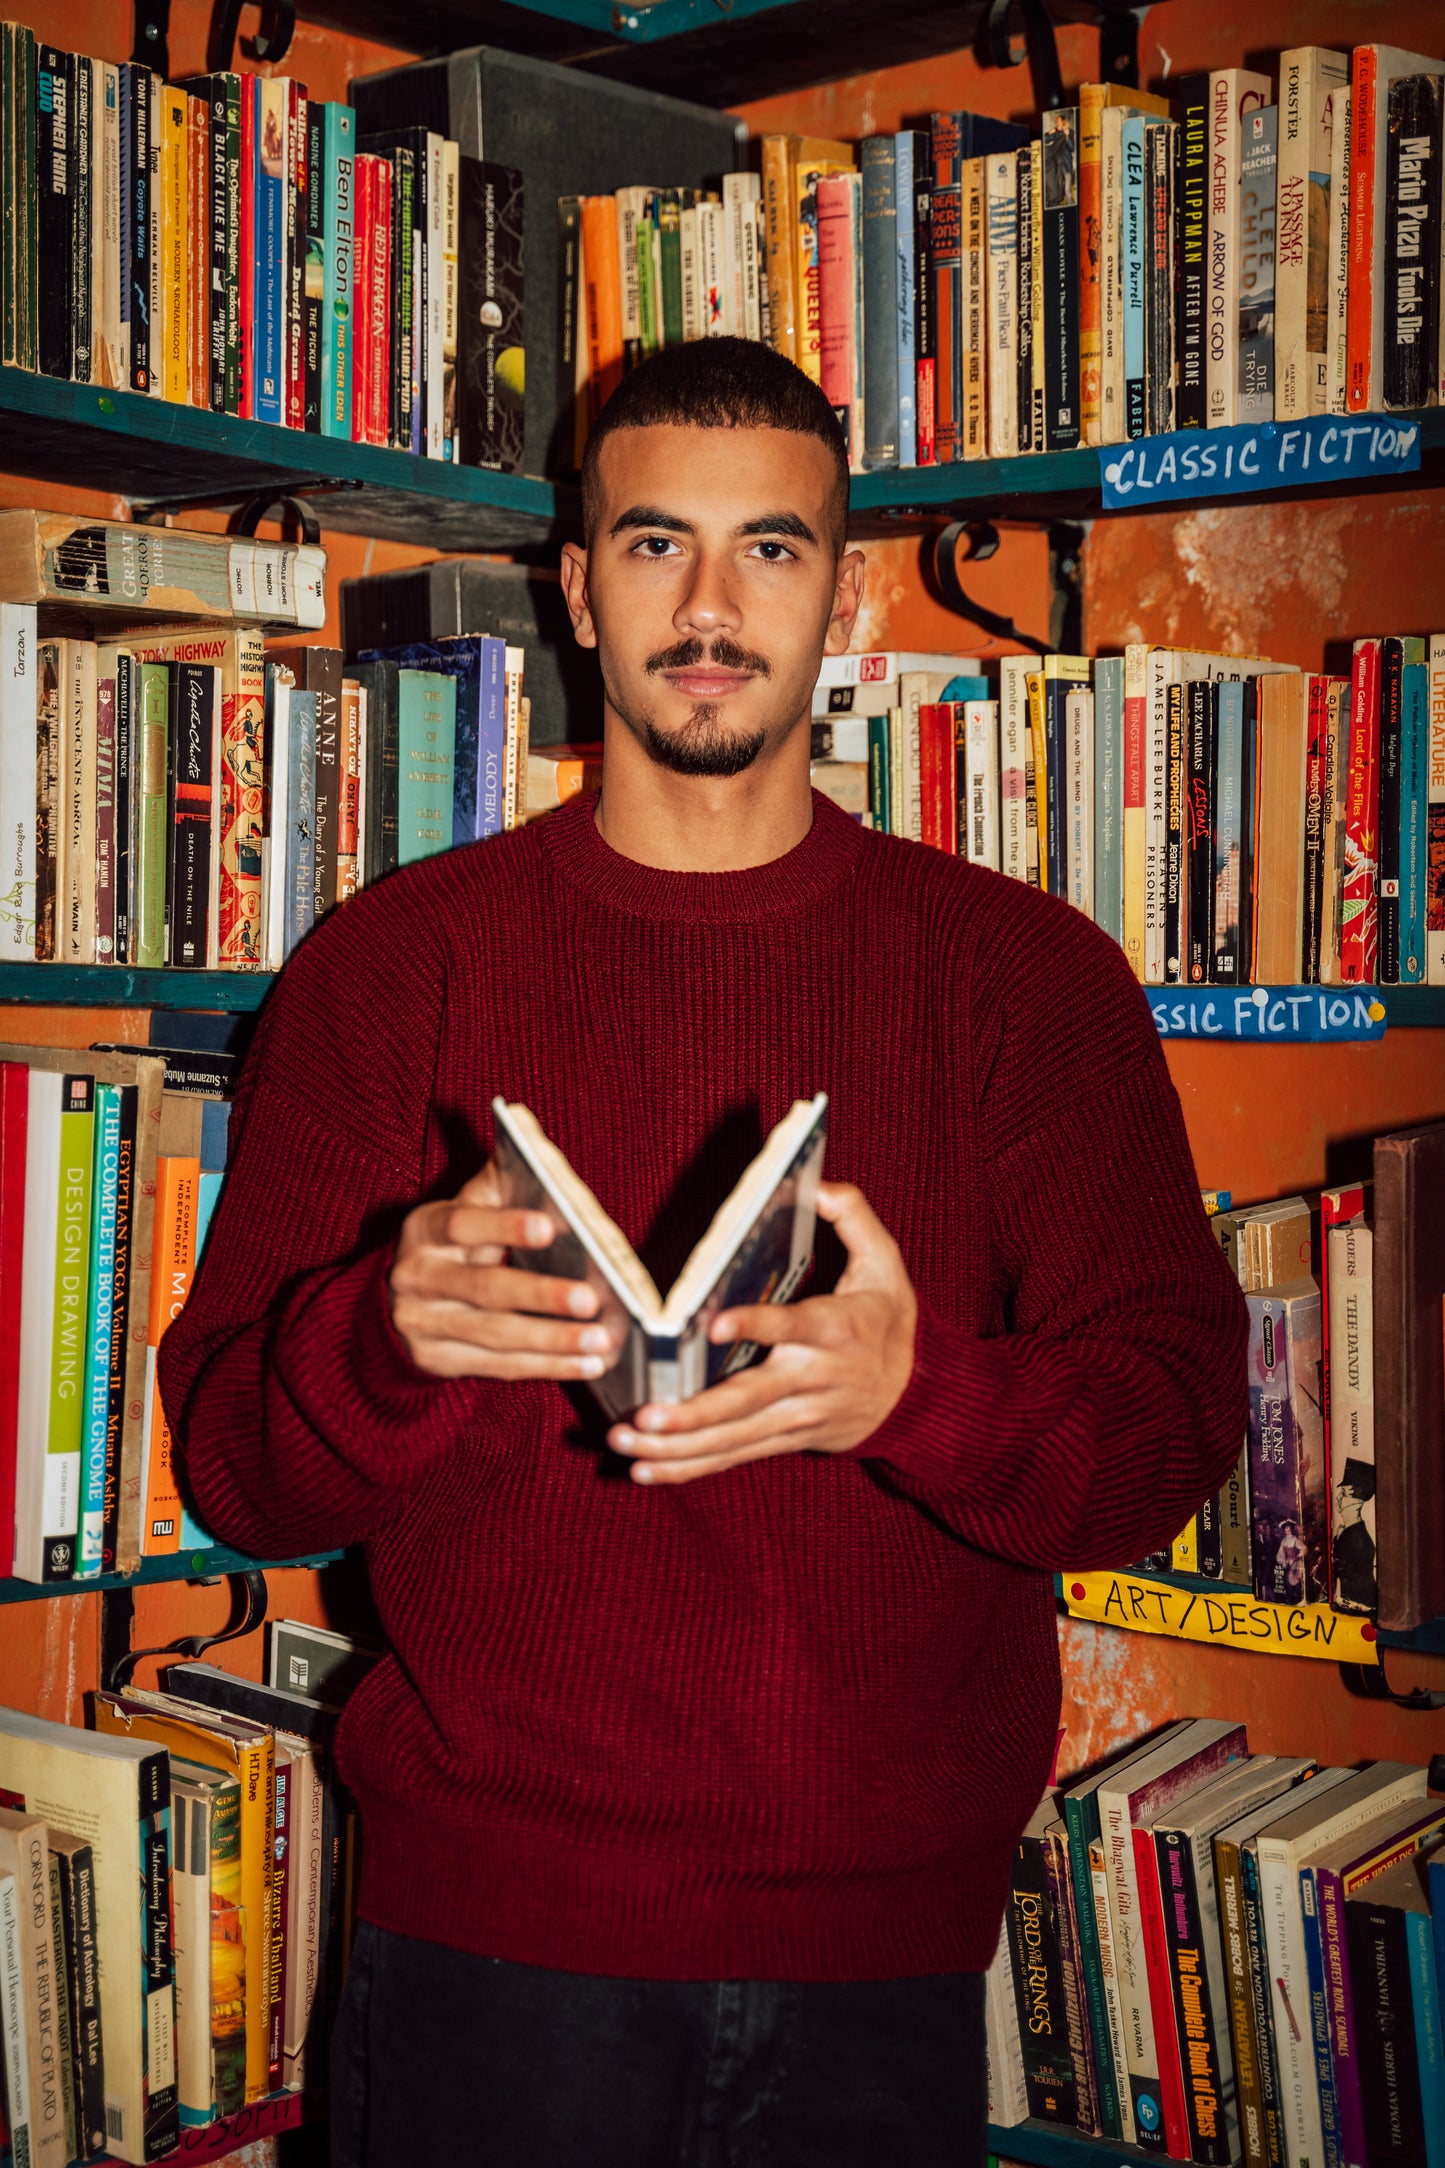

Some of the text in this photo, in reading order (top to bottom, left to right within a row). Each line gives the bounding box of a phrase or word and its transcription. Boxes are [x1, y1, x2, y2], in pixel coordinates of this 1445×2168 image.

[39, 72, 53, 113] CUJO
[52, 76, 67, 195] STEPHEN KING
[1355, 56, 1369, 262] P. G. WODEHOUSE SUMMER LIGHTNING
[135, 77, 146, 259] TONY HILLERMAN Coyote Waits
[213, 133, 225, 253] BLACK LIKE ME
[989, 194, 1017, 255] ALIVE
[1211, 80, 1228, 361] CHINUA ACHEBE ARROW OF GOD
[1279, 183, 1292, 265] TO INDIA
[1287, 65, 1304, 266] FORSTER A PASSAGE
[227, 159, 239, 348] The Optimist's Daughter Eudora Welty
[308, 126, 319, 371] NADINE GORDIMER THE PICKUP
[335, 157, 352, 421] Ben Elton THIS OTHER EDEN
[1127, 142, 1142, 438] CLEA Lawrence Durrell FABER
[1185, 106, 1204, 386] LAURA LIPPMAN AFTER I'M GONE
[1396, 136, 1430, 345] Mario Puzo Fools Die
[1245, 351, 1257, 409] TRYING
[1256, 365, 1268, 390] DIE
[1114, 439, 1260, 493] CLASSIC
[120, 658, 128, 719] MACHIAVELLI
[172, 641, 226, 661] HIGHWAY
[1007, 669, 1019, 752] jennifer egan
[1390, 654, 1397, 662] R.
[323, 692, 336, 765] ANNE
[486, 750, 498, 823] MELODY
[1131, 703, 1140, 801] THINGS FALL APART
[1153, 664, 1163, 821] JAMES LEE BURKE
[1169, 687, 1180, 903] MY LIFE AND PROPHECIES Jeane Dixon
[1193, 692, 1209, 838] LEE ZACHARIAS LESSONS
[1353, 657, 1366, 816] William Golding Lord of the Flies
[1432, 671, 1444, 786] LITERATURE
[98, 734, 112, 887] MIMA TOM HANLIN
[186, 866, 193, 881] ON
[1147, 846, 1155, 929] PRISONERS
[88, 1103, 119, 1501] THE COMPLETE BOOK OF THE GNOME
[110, 1140, 131, 1389] EGYPTIAN YOGA Volume II
[58, 1167, 84, 1528] DESIGN DRAWING SECOND EDITION
[1346, 1294, 1360, 1447] THE DANDY VIKING
[1259, 1394, 1272, 1462] Henry Fielding
[1271, 1393, 1284, 1464] TOM JONES
[1105, 1580, 1337, 1645] ART/DESIGN
[1108, 1809, 1123, 1832] The
[1110, 1836, 1127, 1888] Bhagwat
[79, 1869, 99, 2065] Dictionary of Astrology Dal Lee
[147, 1842, 167, 1978] Introducing Philosophy
[270, 1868, 286, 2003] Bizarre Thailand
[1015, 1890, 1050, 2035] LORD RINGS
[1114, 1891, 1132, 1915] Gita
[1324, 1885, 1348, 2056] THE WORLD'S GREATEST ROYAL SCANDALS
[27, 1840, 58, 2121] CORNFORD THE REPUBLIC OF PLATO
[1133, 2023, 1144, 2058] VARMA
[1177, 1948, 1215, 2137] The Complete Book of Chess
